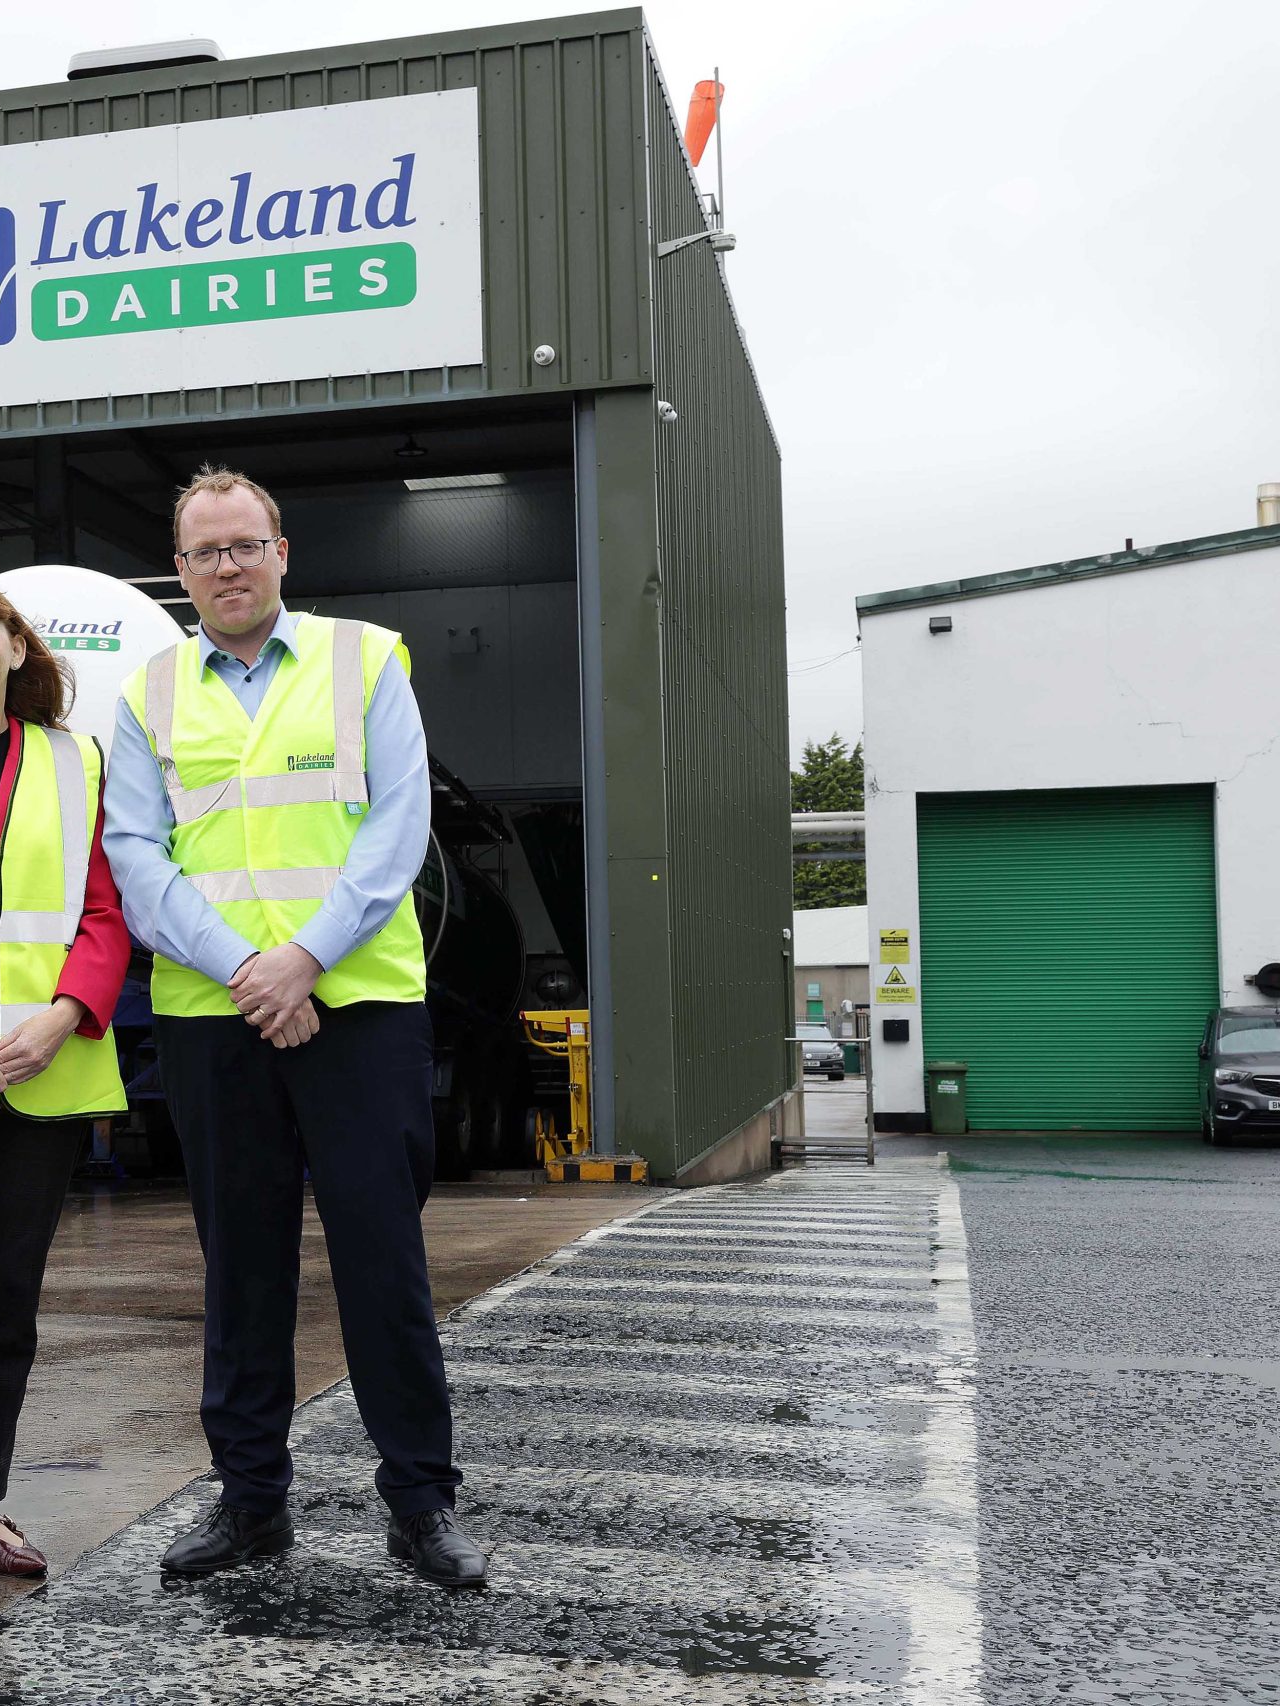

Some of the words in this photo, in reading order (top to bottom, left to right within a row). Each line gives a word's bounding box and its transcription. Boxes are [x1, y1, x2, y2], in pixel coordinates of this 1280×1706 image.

[31, 153, 417, 266] Lakeland
[57, 258, 389, 328] DAIRIES
[34, 618, 122, 636] eland
[296, 752, 335, 763] Lakeland
